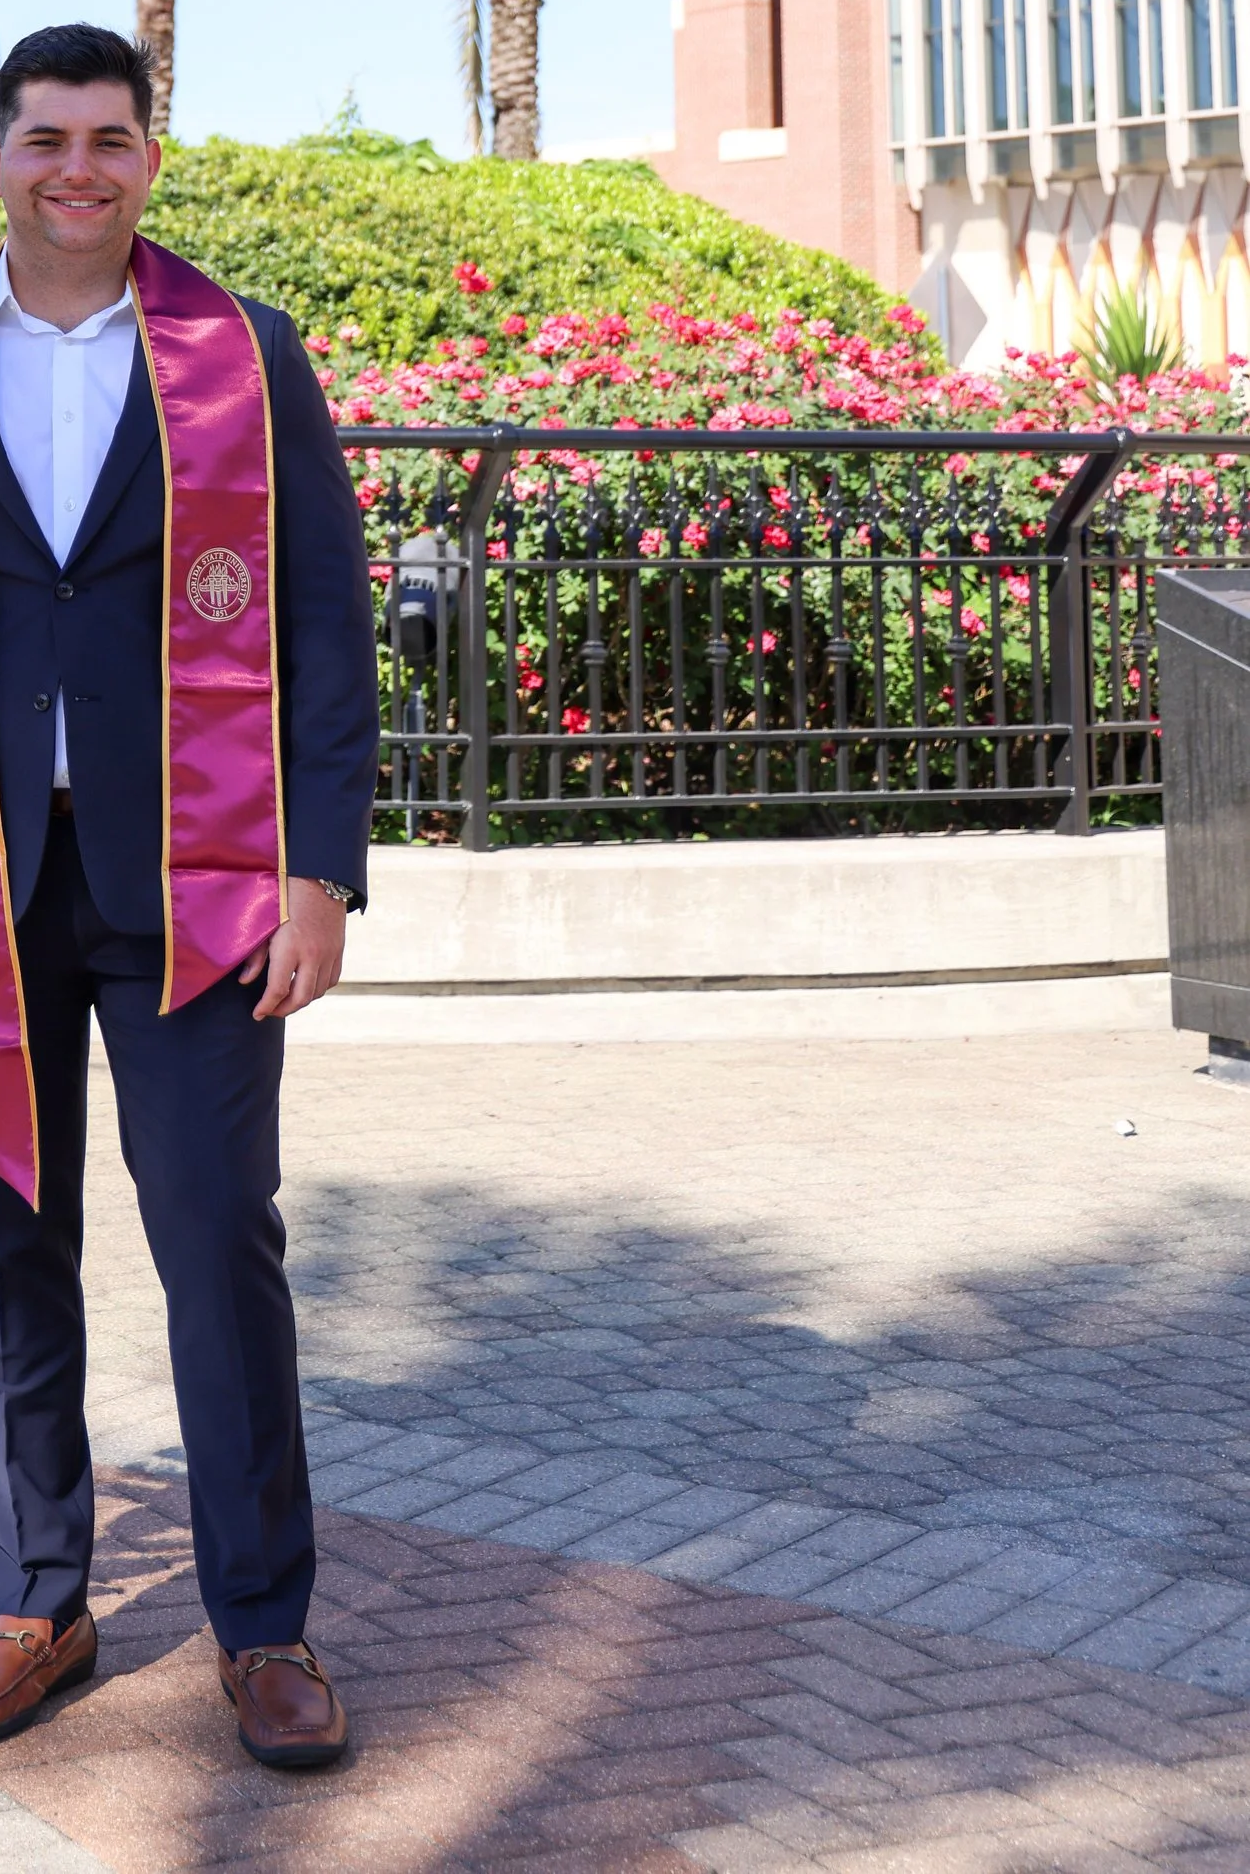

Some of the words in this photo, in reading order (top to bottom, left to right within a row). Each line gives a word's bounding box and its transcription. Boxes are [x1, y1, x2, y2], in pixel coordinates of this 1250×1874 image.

[191, 566, 202, 604] FLORIDA
[202, 552, 224, 565] STATE
[226, 555, 247, 604] UNIVERSITY
[212, 609, 228, 617] 1851
